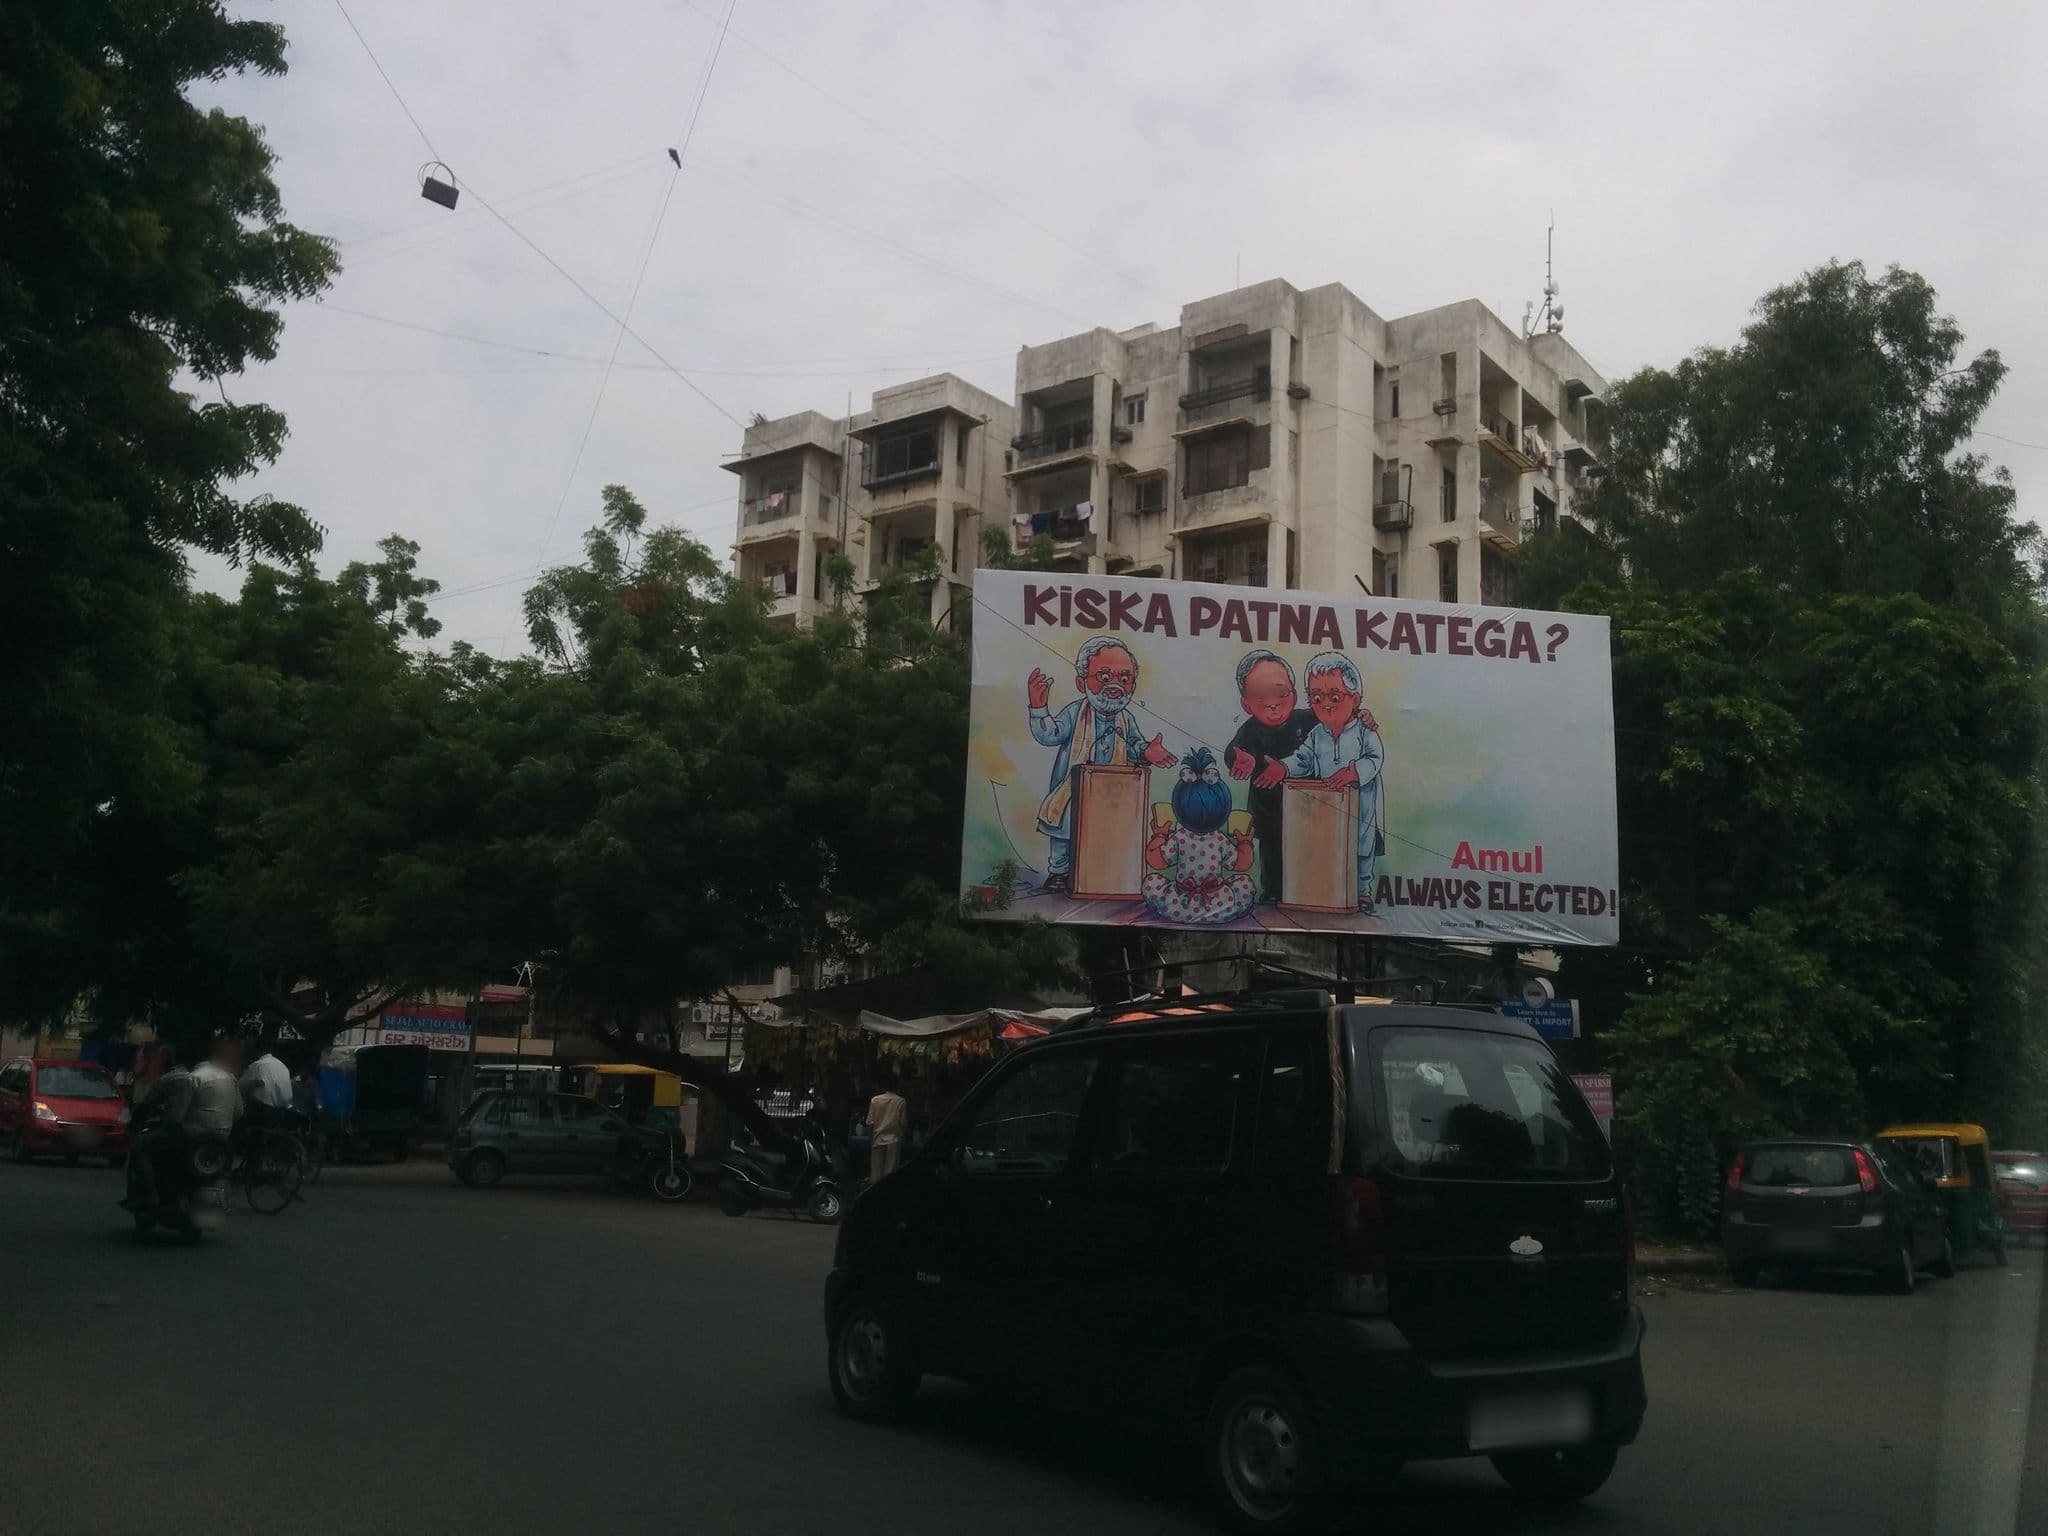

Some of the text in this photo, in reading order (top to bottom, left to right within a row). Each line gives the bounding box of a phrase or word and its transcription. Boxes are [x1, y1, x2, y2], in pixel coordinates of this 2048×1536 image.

[1189, 596, 1344, 650] PATNA
[1355, 608, 1569, 664] KATEGA?
[1450, 840, 1543, 874] Amul
[1375, 875, 1616, 917] ALWAYS ELECTED!
[416, 1018, 440, 1028] AUTO
[1542, 1018, 1572, 1026] IMPORT
